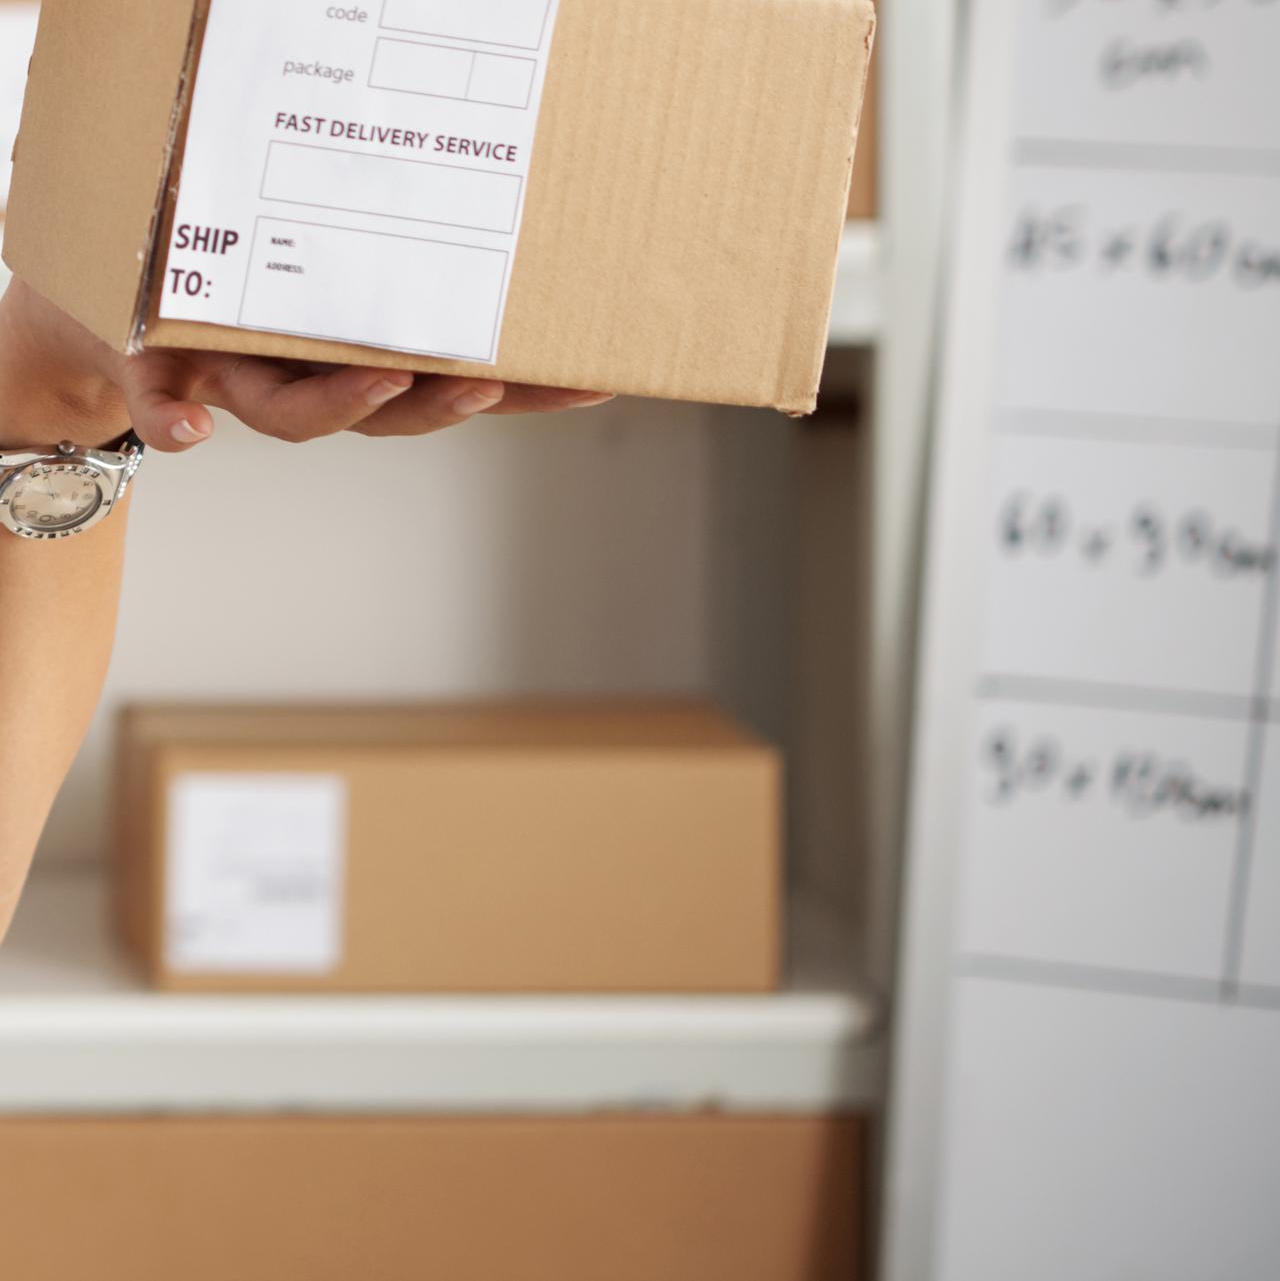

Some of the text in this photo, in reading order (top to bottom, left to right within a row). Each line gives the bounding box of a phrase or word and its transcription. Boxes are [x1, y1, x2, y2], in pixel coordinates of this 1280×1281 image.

[327, 7, 367, 22] code
[284, 62, 353, 83] package
[276, 113, 517, 162] FAST DELIVERY SERVICE
[174, 224, 239, 255] SHIP
[171, 268, 211, 298] TO:
